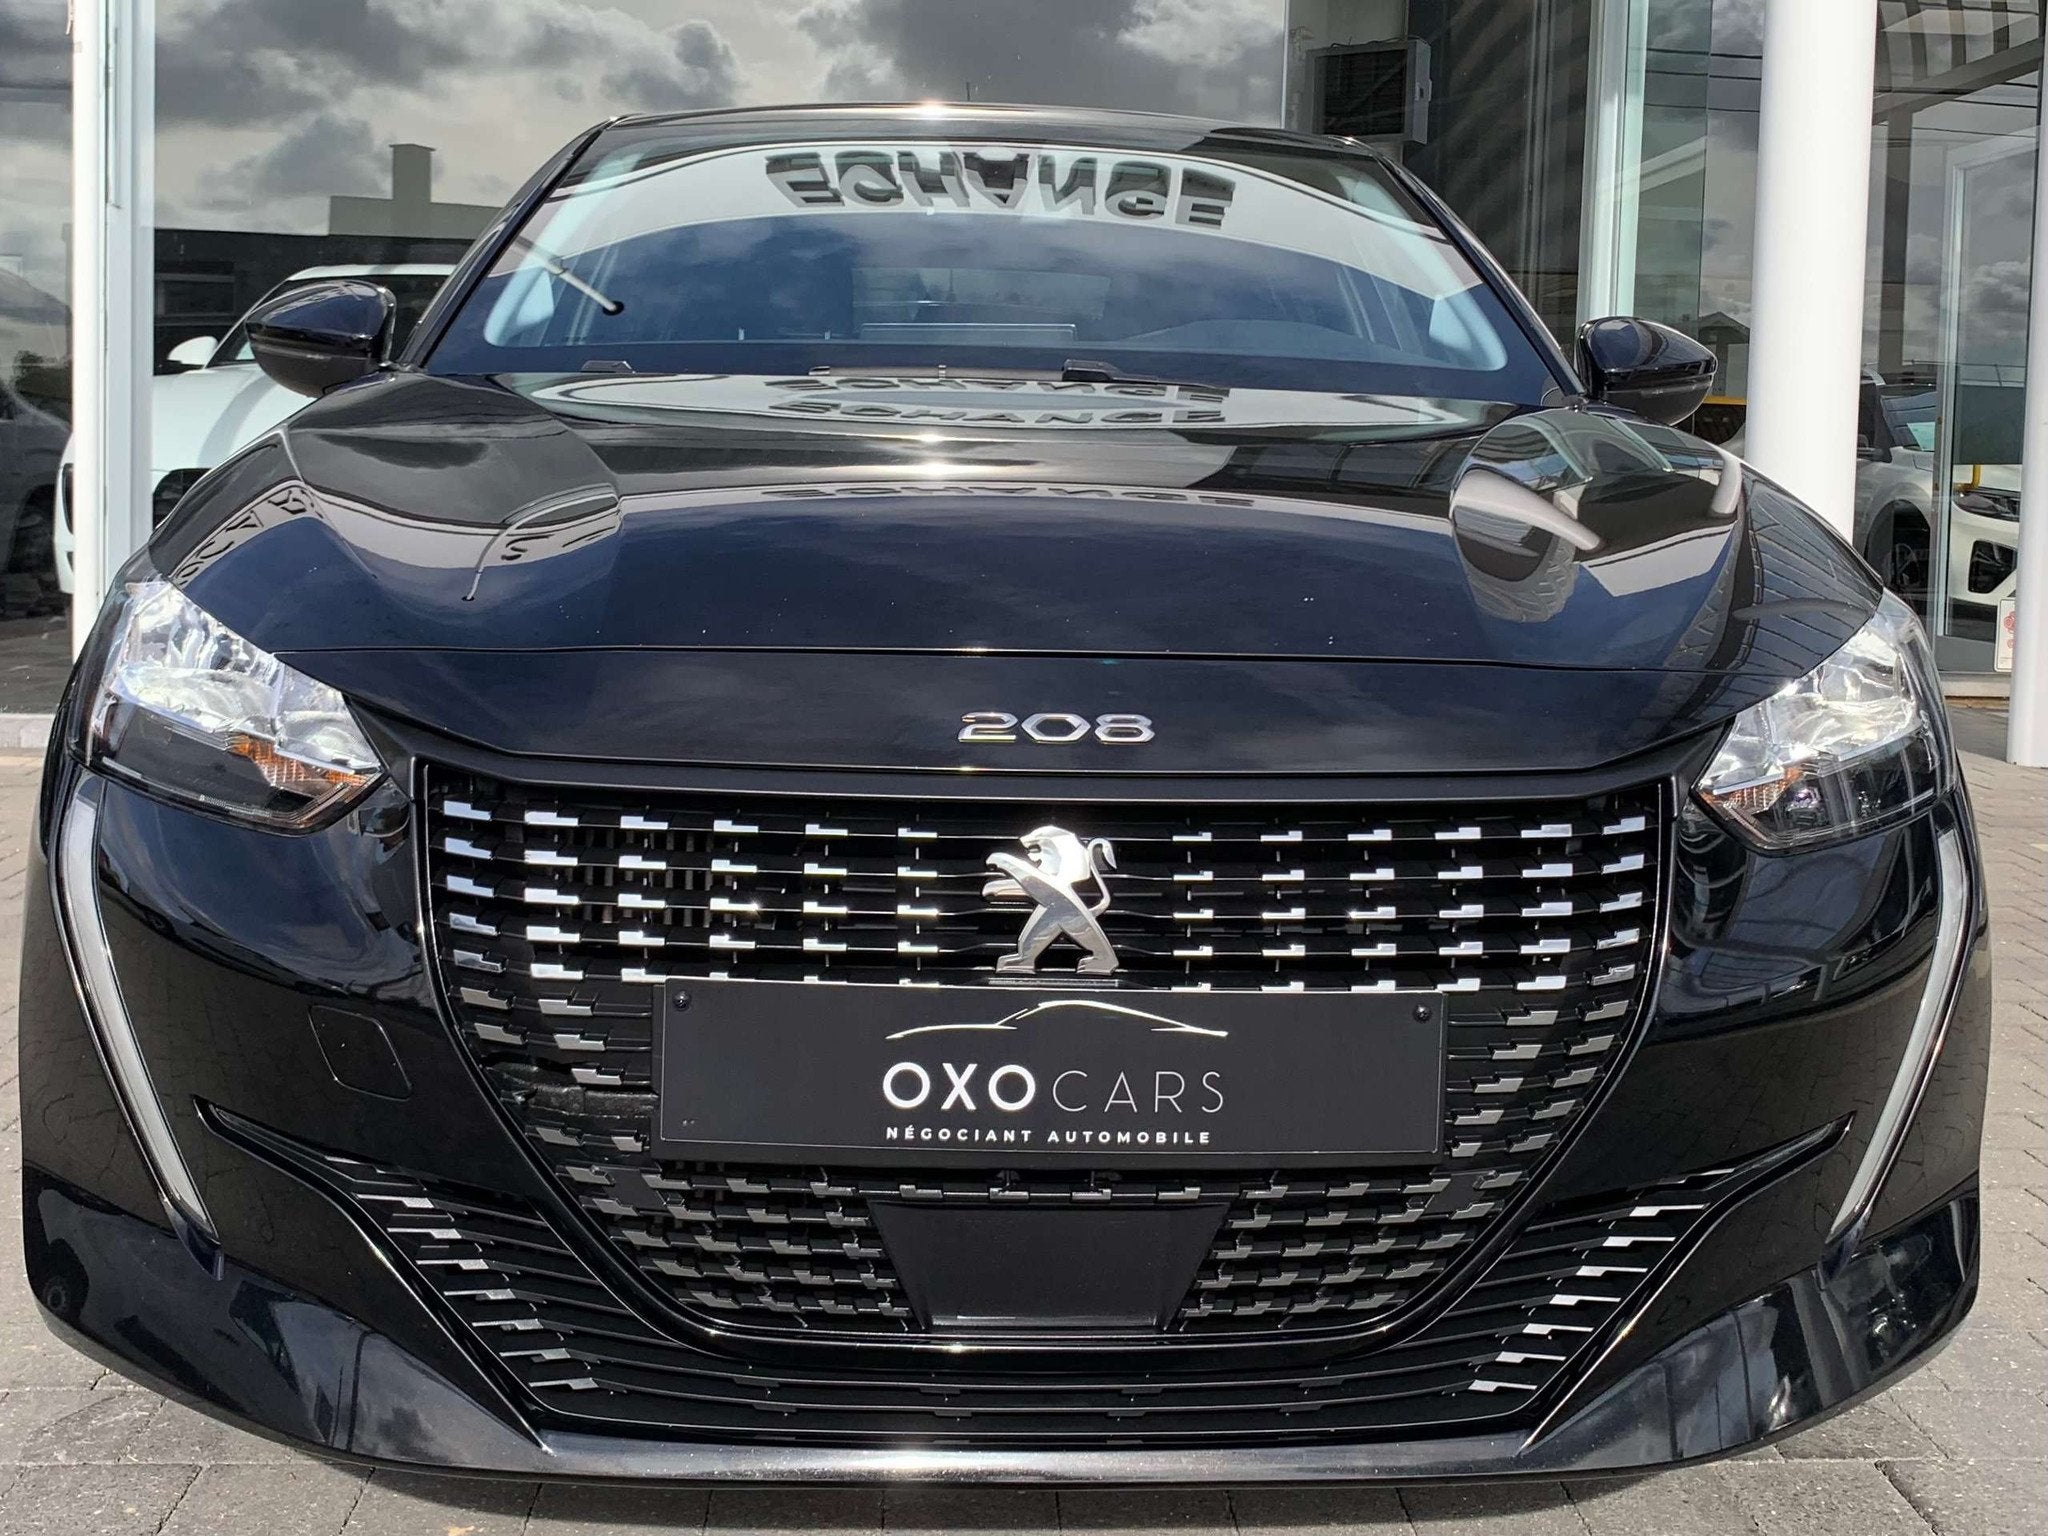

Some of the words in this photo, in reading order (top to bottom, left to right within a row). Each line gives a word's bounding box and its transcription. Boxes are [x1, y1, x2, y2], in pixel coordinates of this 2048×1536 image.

[958, 711, 1155, 744] 208
[882, 1061, 1036, 1111] OXO
[1052, 1070, 1224, 1113] CARS
[886, 1124, 1032, 1142] NÉGOCIANT
[1047, 1130, 1210, 1144] AUTOMOBILE
